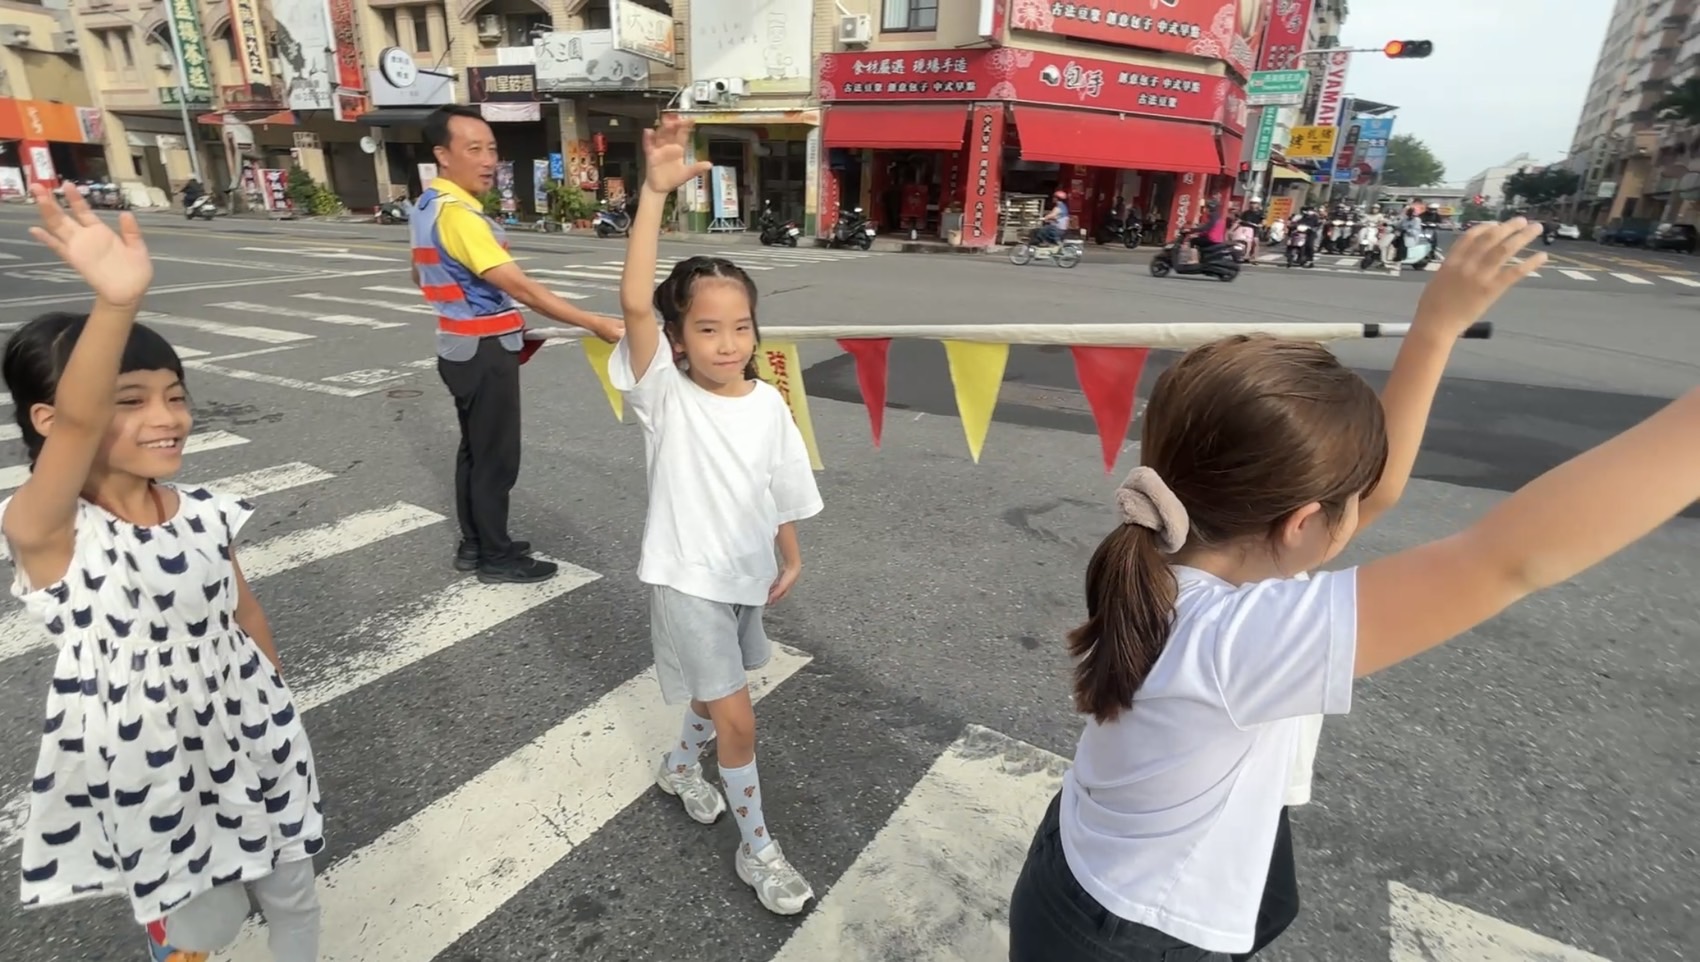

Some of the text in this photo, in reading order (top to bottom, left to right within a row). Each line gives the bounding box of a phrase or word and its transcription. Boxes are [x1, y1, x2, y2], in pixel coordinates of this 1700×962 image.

[852, 57, 967, 75] 食材嚴選 現場手造
[1317, 68, 1346, 126] YAMAH
